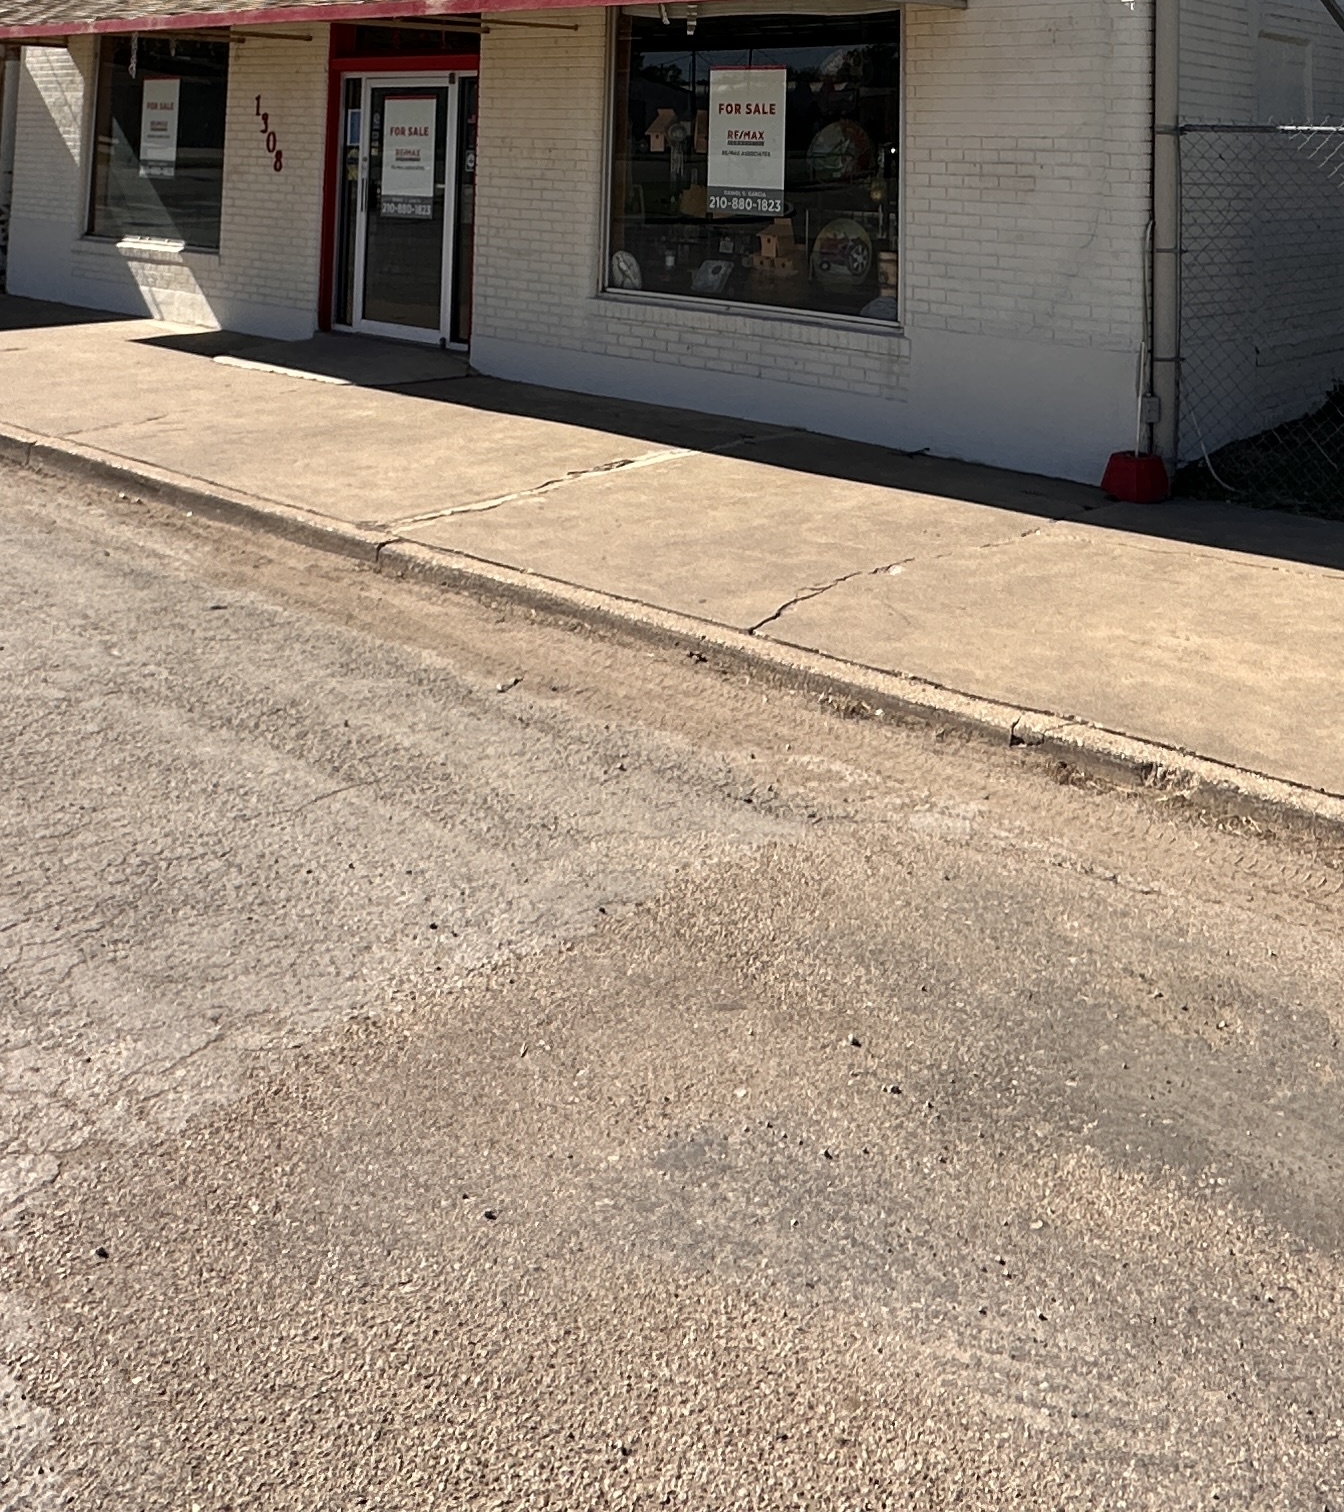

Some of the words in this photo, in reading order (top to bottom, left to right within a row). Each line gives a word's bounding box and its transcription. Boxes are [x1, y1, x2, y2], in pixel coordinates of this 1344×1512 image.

[718, 102, 741, 115] FOR
[745, 102, 776, 115] SALE
[255, 94, 284, 173] 1308
[390, 126, 406, 137] FOR
[408, 126, 429, 137] SALE
[727, 130, 764, 140] RE/MAX
[709, 196, 781, 212] 210-880-1823
